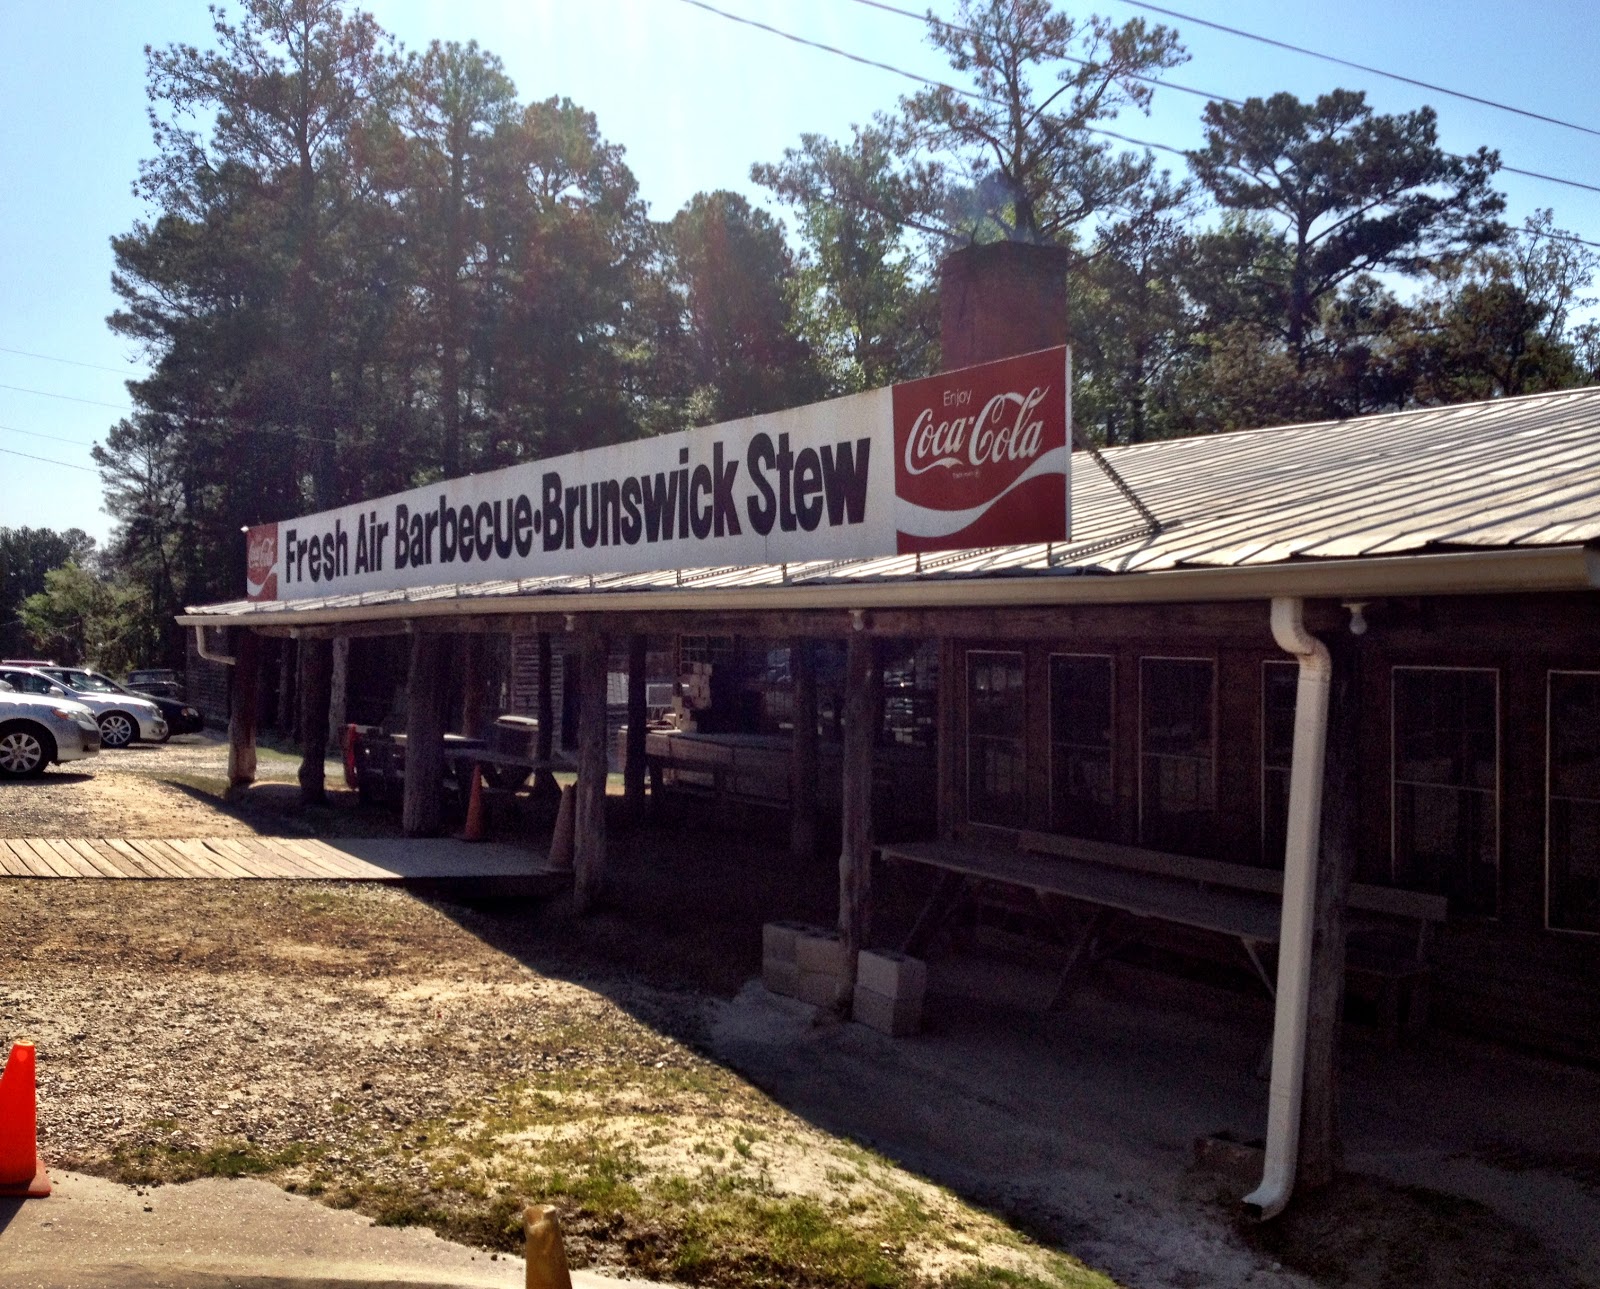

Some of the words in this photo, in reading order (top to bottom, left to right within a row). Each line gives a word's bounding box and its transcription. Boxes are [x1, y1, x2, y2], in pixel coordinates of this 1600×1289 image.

[943, 389, 973, 407] Enjoy
[285, 519, 348, 583] Fresh
[354, 511, 389, 574] Air
[394, 494, 533, 570] Barbecue
[542, 441, 742, 552] Brunswick
[746, 432, 871, 536] Stew
